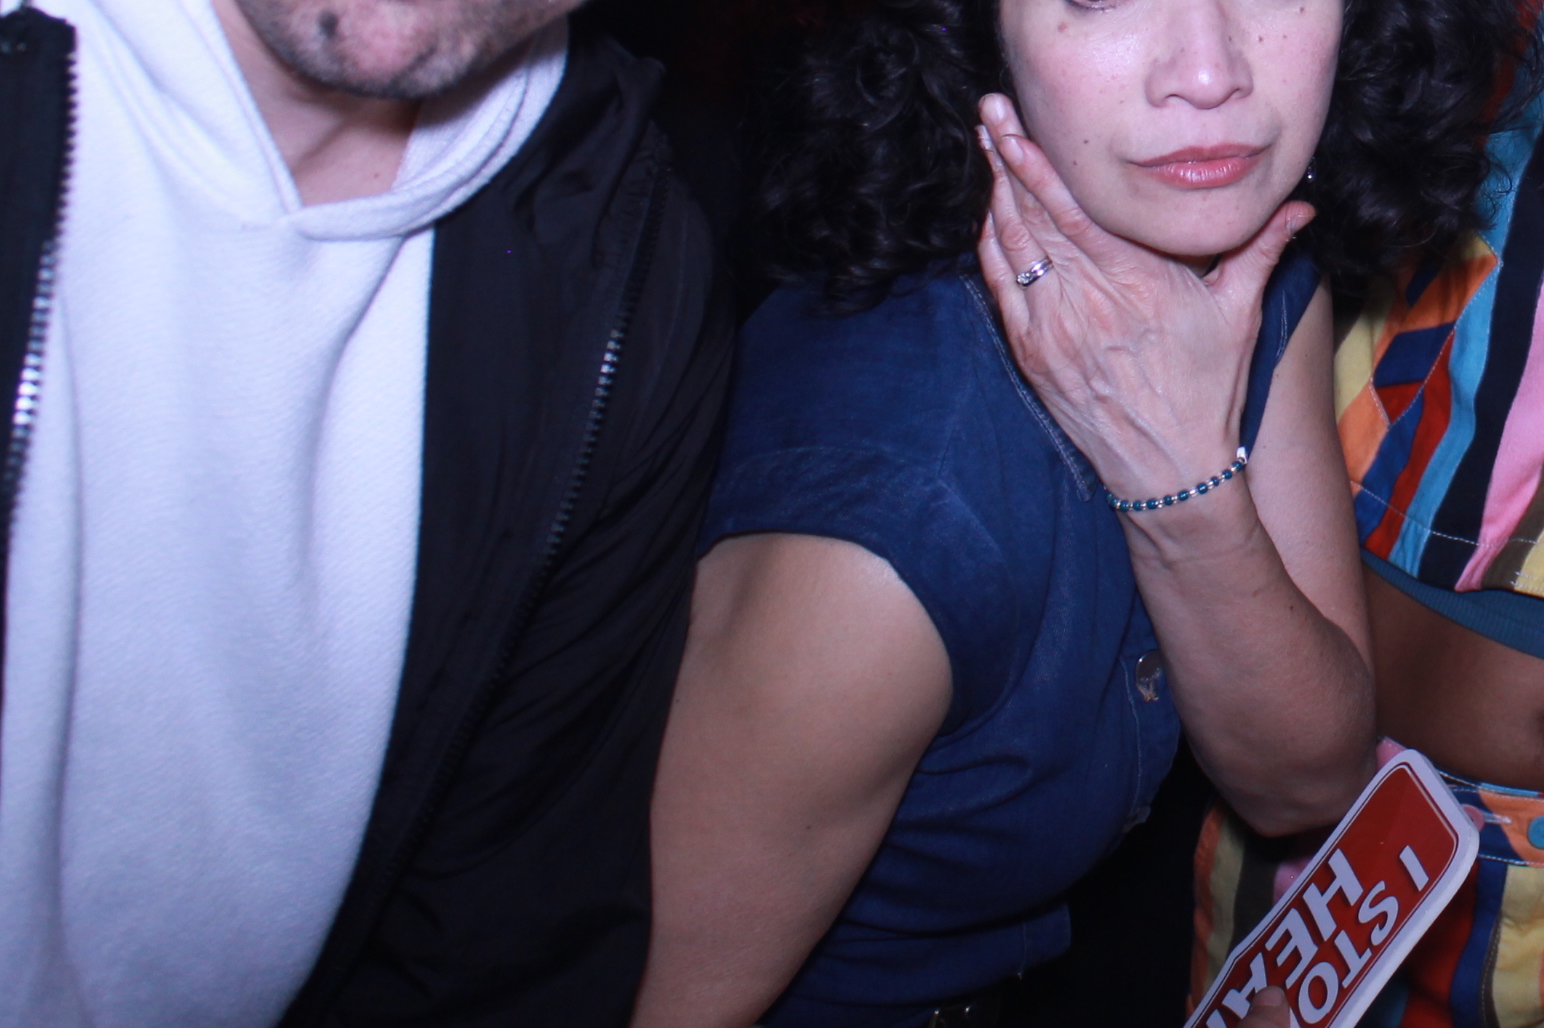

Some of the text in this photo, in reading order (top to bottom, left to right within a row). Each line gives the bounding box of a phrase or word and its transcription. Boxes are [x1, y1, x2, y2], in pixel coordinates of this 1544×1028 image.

[1206, 849, 1363, 1028] HEA
[1290, 845, 1430, 1028] I STO
